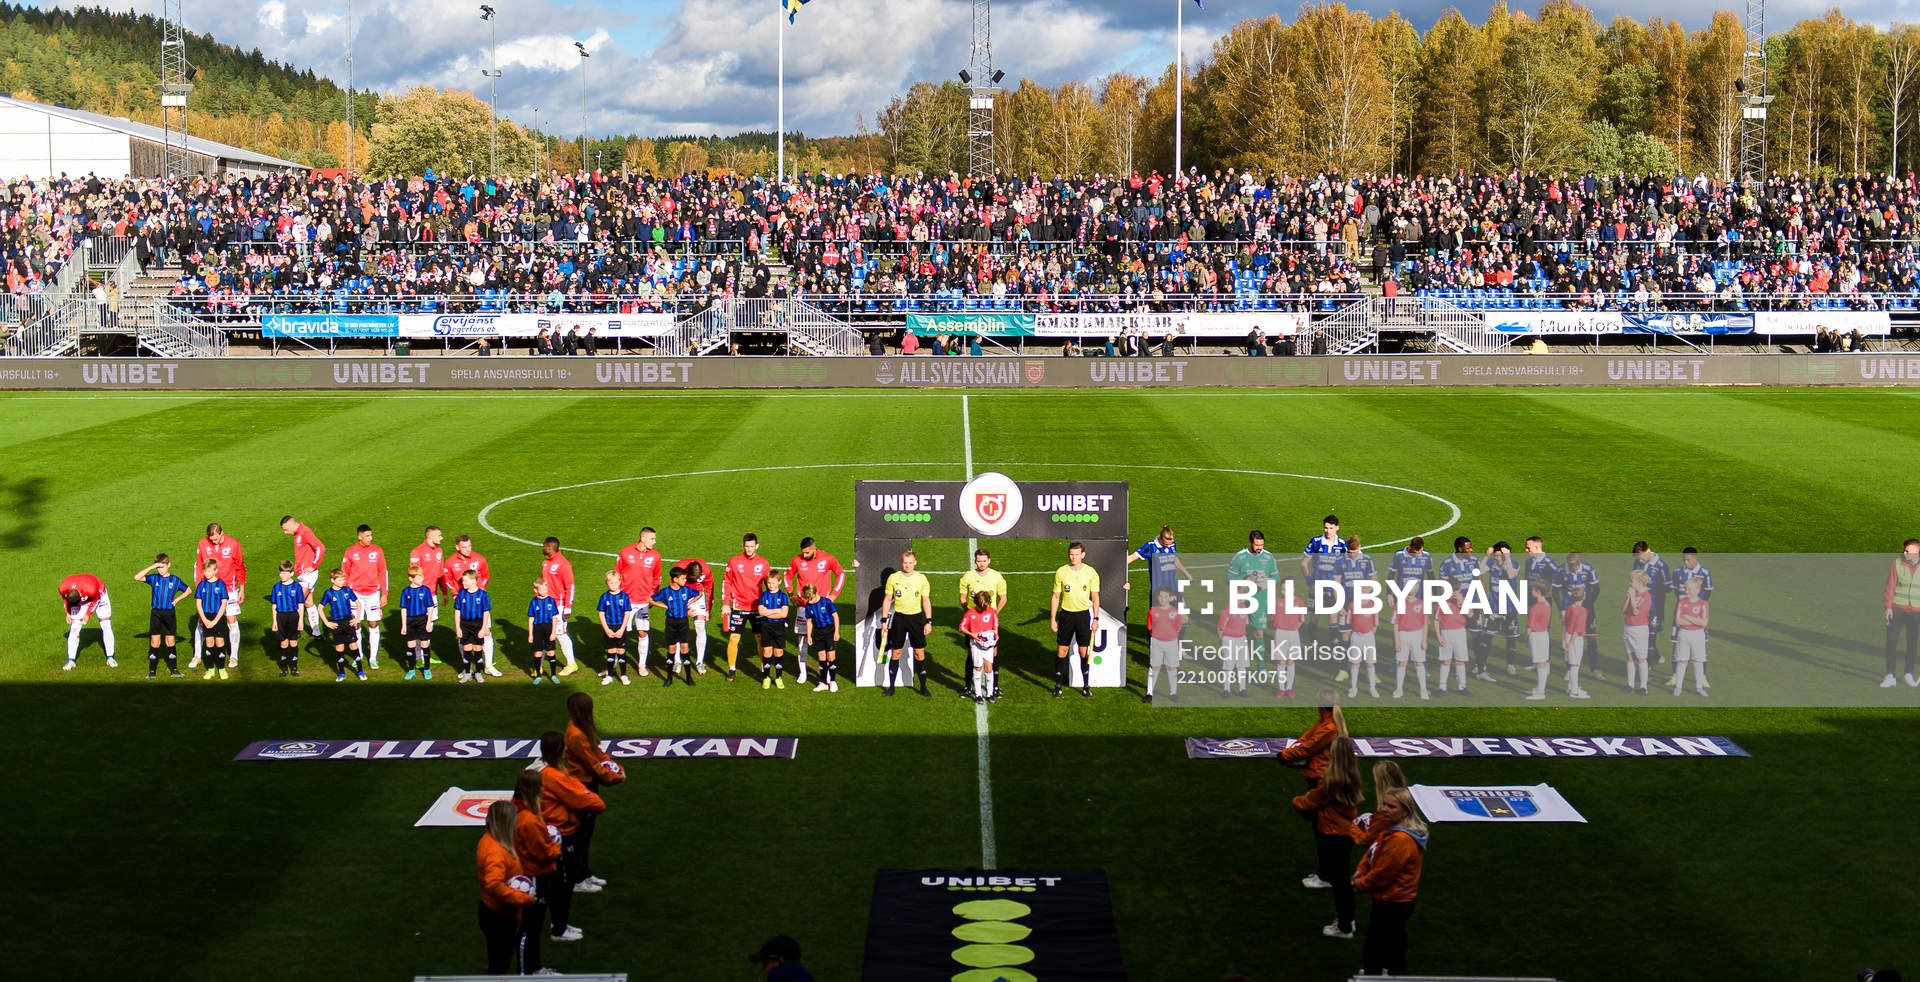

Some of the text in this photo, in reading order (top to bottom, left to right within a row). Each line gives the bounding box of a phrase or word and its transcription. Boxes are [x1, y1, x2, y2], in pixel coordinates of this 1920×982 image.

[281, 317, 338, 334] bravida
[926, 318, 1006, 332] Assemblin
[44, 370, 59, 379] 18+
[82, 363, 179, 384] UNIBET
[333, 363, 431, 383] UNIBET
[450, 369, 572, 379] SPELA ANSVARSFULLT 18+
[595, 362, 694, 383] UNIBET
[900, 362, 1020, 384] ALLSVENSKAN
[1090, 361, 1188, 382] UNIBET
[1343, 360, 1442, 380] UNIBET
[1462, 366, 1492, 376] SPELA
[1495, 366, 1567, 376] ANSVARSFULLT
[1607, 359, 1704, 380] UNIBET
[869, 494, 944, 511] UNIBET
[1037, 494, 1113, 512] UNIBET
[328, 739, 780, 758] ALLSVSKAN
[1286, 737, 1729, 757] LSVENSKAN
[1447, 790, 1526, 798] SIRIUS
[921, 877, 1062, 886] UNIBET
